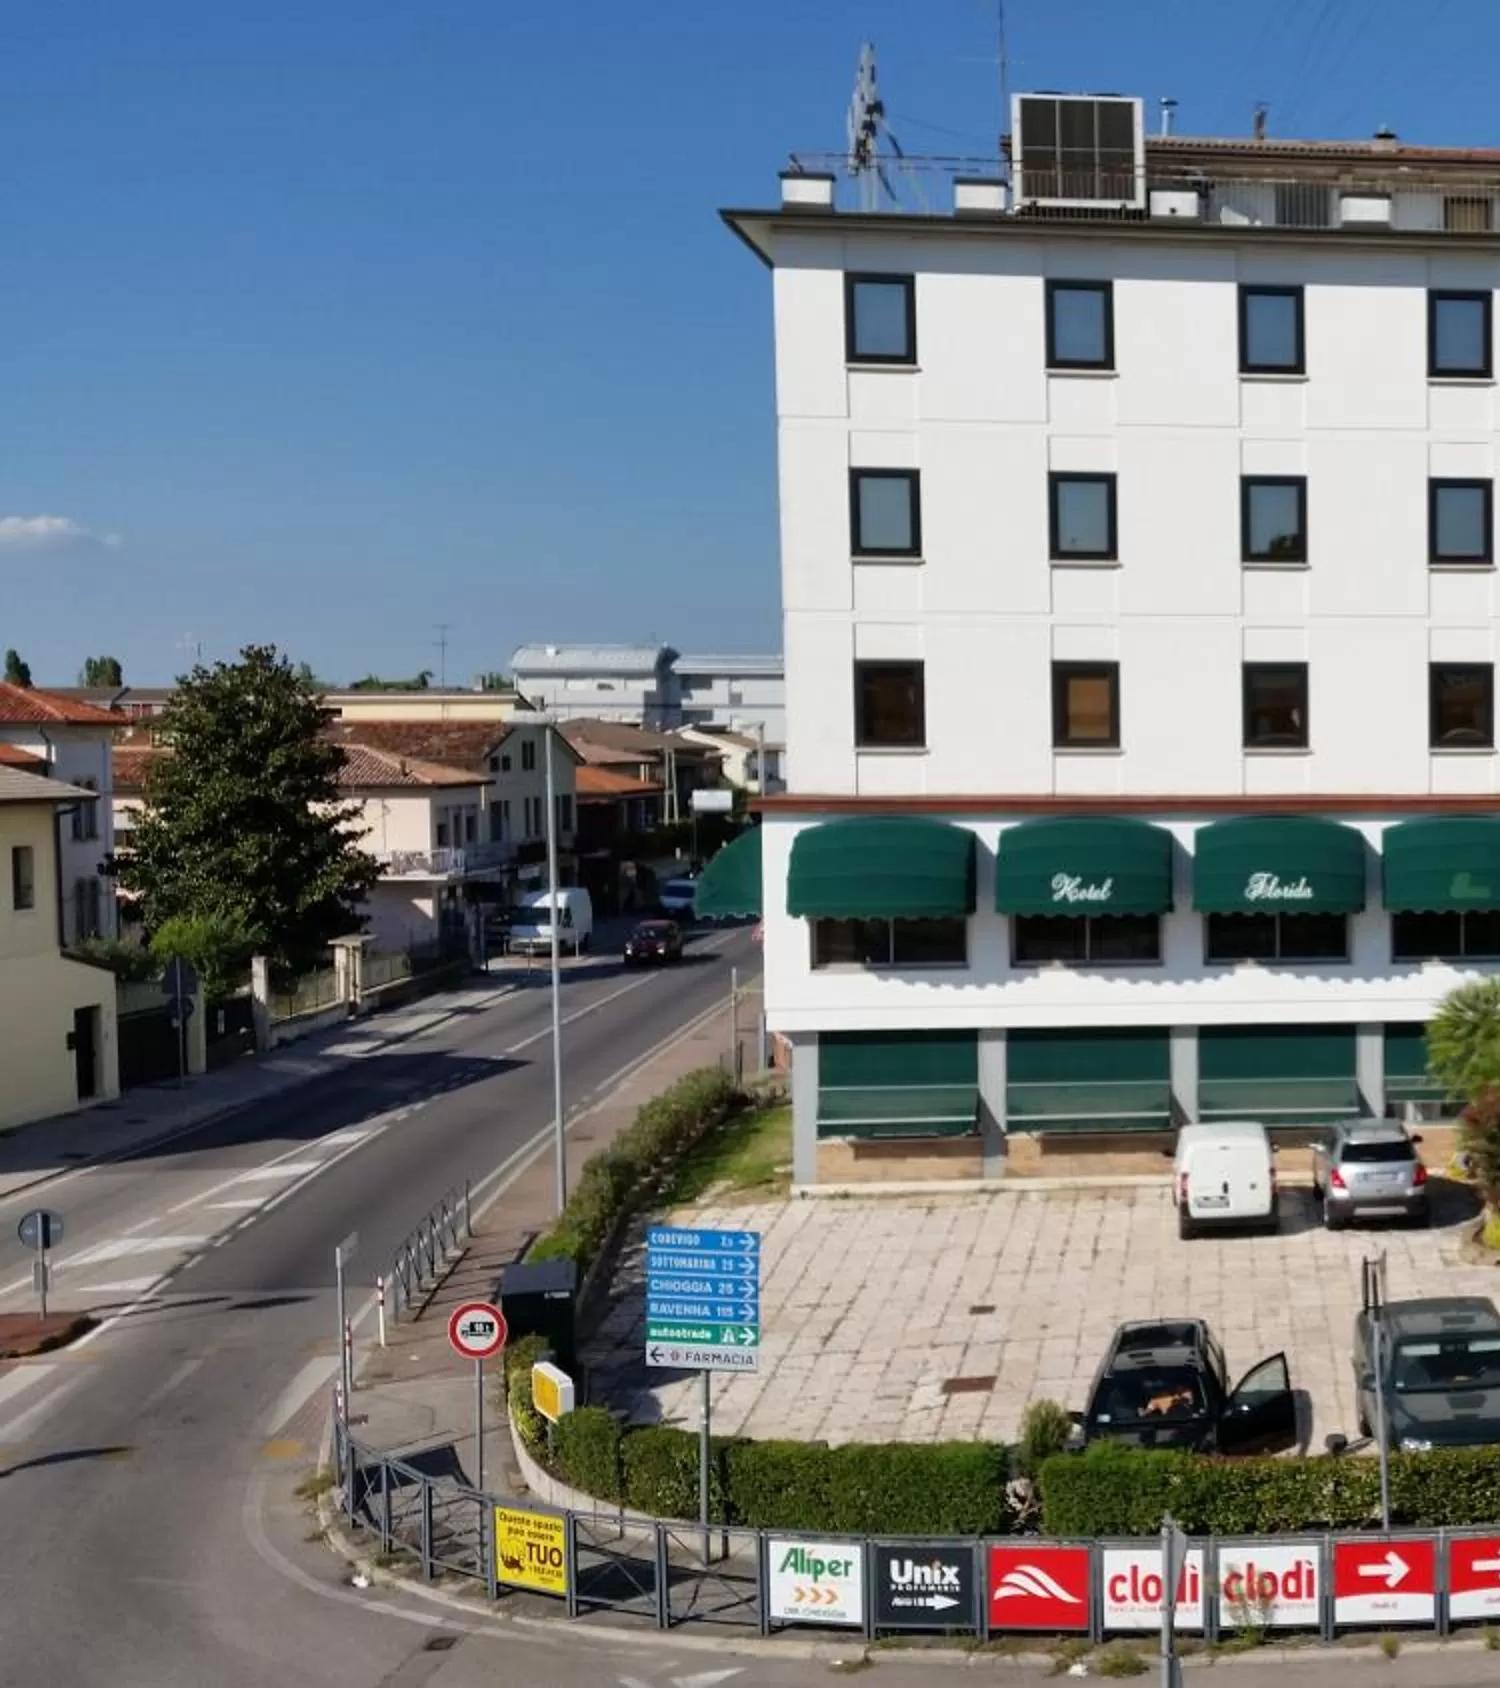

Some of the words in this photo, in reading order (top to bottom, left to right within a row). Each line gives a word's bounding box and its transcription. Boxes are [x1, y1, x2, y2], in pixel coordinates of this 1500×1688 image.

[1051, 872, 1112, 903] Hotel
[1244, 871, 1314, 901] Florida
[651, 1279, 712, 1293] CHIOGGIA
[650, 1303, 711, 1317] RAVENNA
[685, 1351, 753, 1365] FARMACIA
[526, 1542, 562, 1568] TUO
[779, 1548, 853, 1582] Aliper
[889, 1557, 960, 1585] Unix
